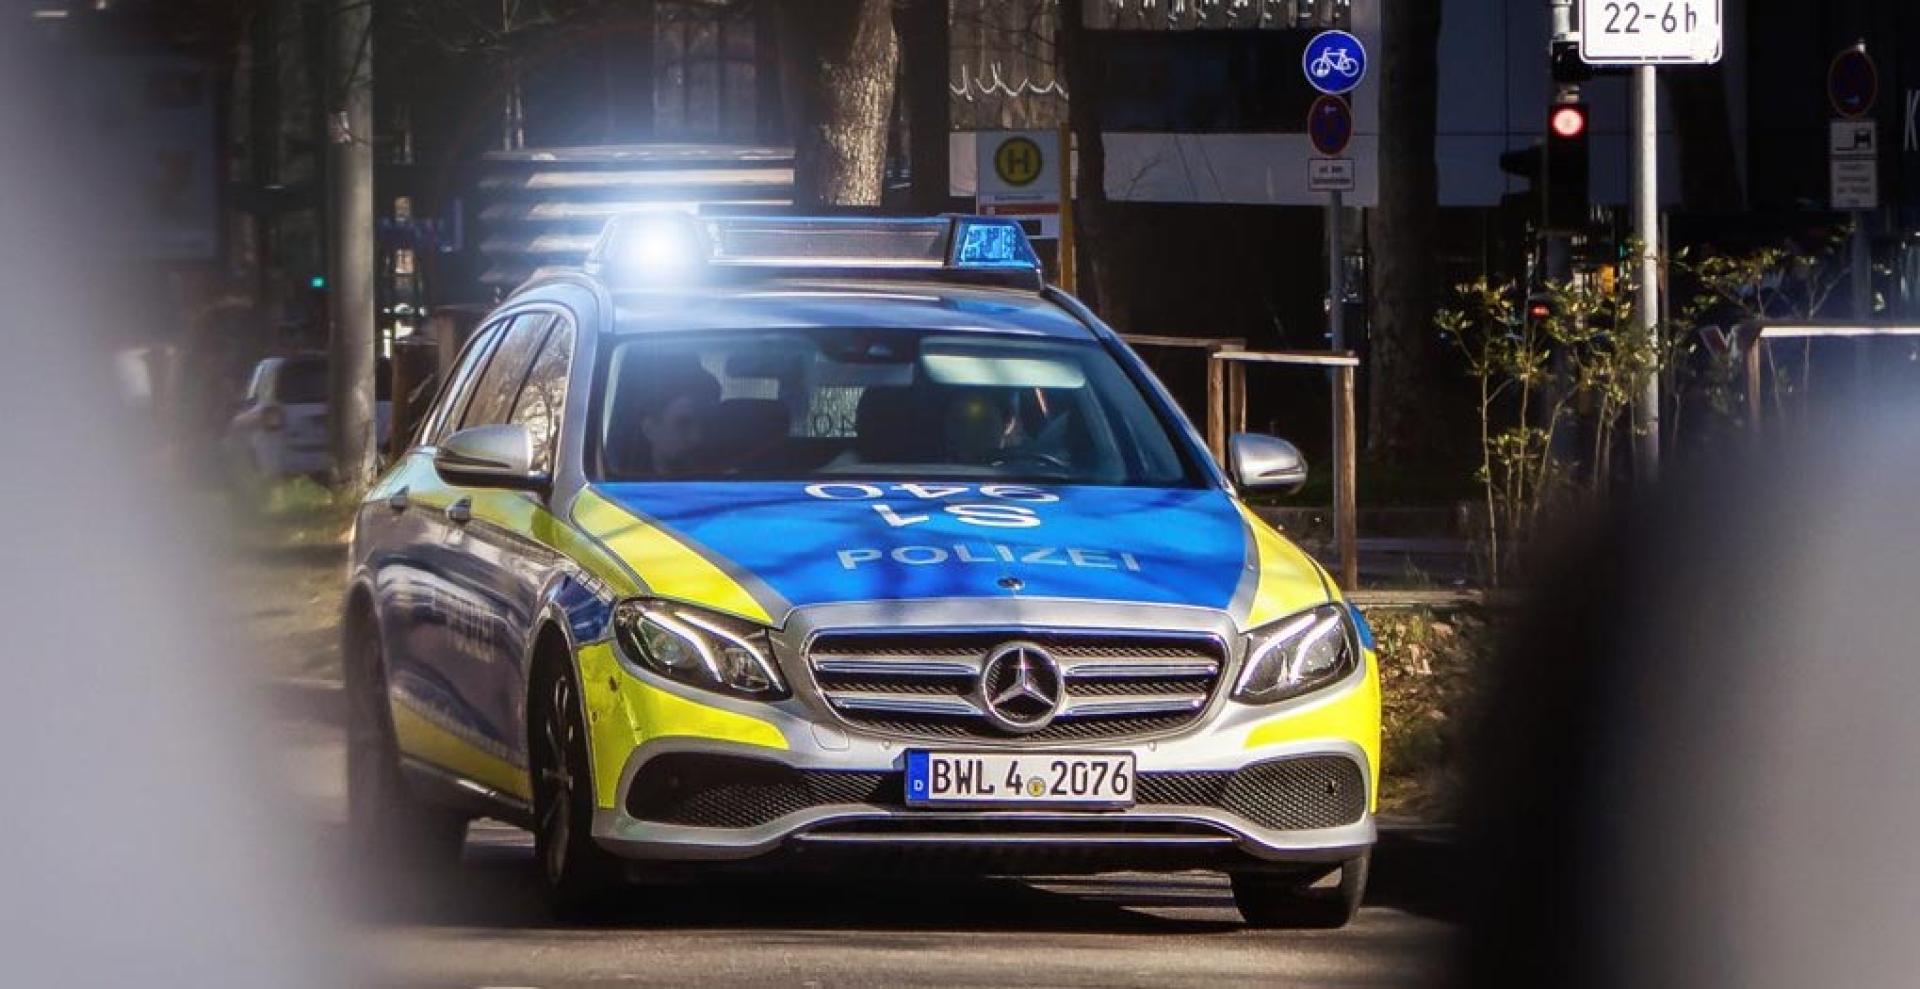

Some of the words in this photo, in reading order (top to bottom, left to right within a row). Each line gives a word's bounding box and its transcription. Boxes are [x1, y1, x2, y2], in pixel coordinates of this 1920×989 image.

[1604, 2, 1677, 33] 22-6
[1685, 2, 1697, 33] h
[1008, 149, 1028, 174] H
[872, 503, 1041, 528] S1
[838, 544, 1141, 572] POLIZEI
[914, 780, 923, 791] D
[932, 758, 995, 794] BWL
[1005, 760, 1024, 795] 4
[1050, 760, 1128, 796] 2076
